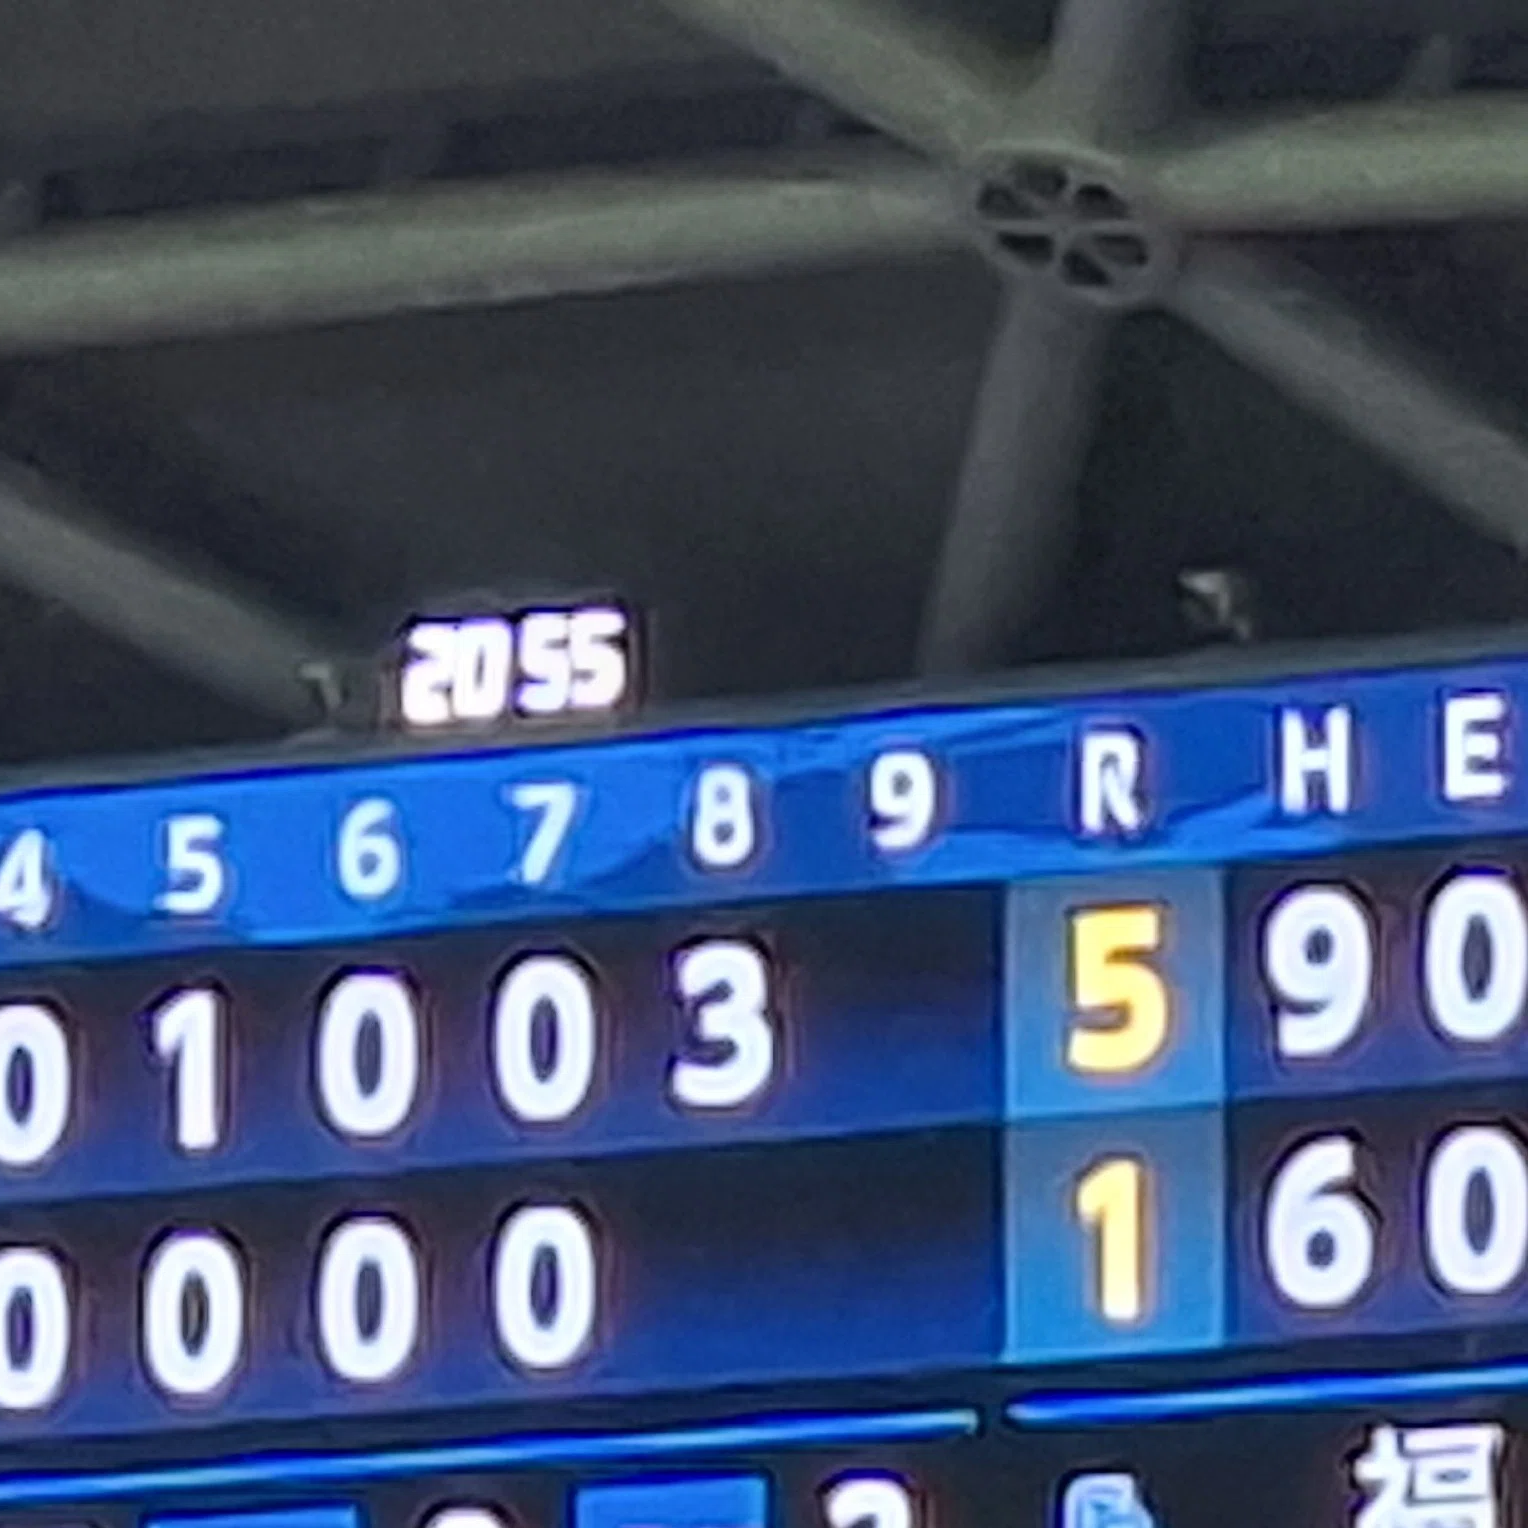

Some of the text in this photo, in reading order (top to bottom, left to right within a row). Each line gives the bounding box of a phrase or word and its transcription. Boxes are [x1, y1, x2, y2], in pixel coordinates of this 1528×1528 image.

[158, 814, 224, 914] 5
[337, 798, 401, 899] 6
[511, 781, 577, 883] 7
[692, 764, 754, 867] 8
[870, 751, 935, 851] 9
[1080, 731, 1144, 834] R
[1281, 706, 1351, 813] H
[1443, 693, 1510, 801] E
[156, 989, 219, 1150] 1
[318, 974, 419, 1136] 0
[495, 957, 595, 1122] 0
[672, 940, 774, 1107] 3
[1068, 906, 1169, 1074] 5
[1266, 889, 1373, 1057] 9
[1424, 875, 1528, 1042] 0
[144, 1235, 243, 1396] 0
[319, 1218, 419, 1383] 0
[495, 1206, 596, 1369] 0
[1076, 1159, 1142, 1322] 1
[1267, 1136, 1374, 1307] 6
[1426, 1126, 1528, 1294] 0
